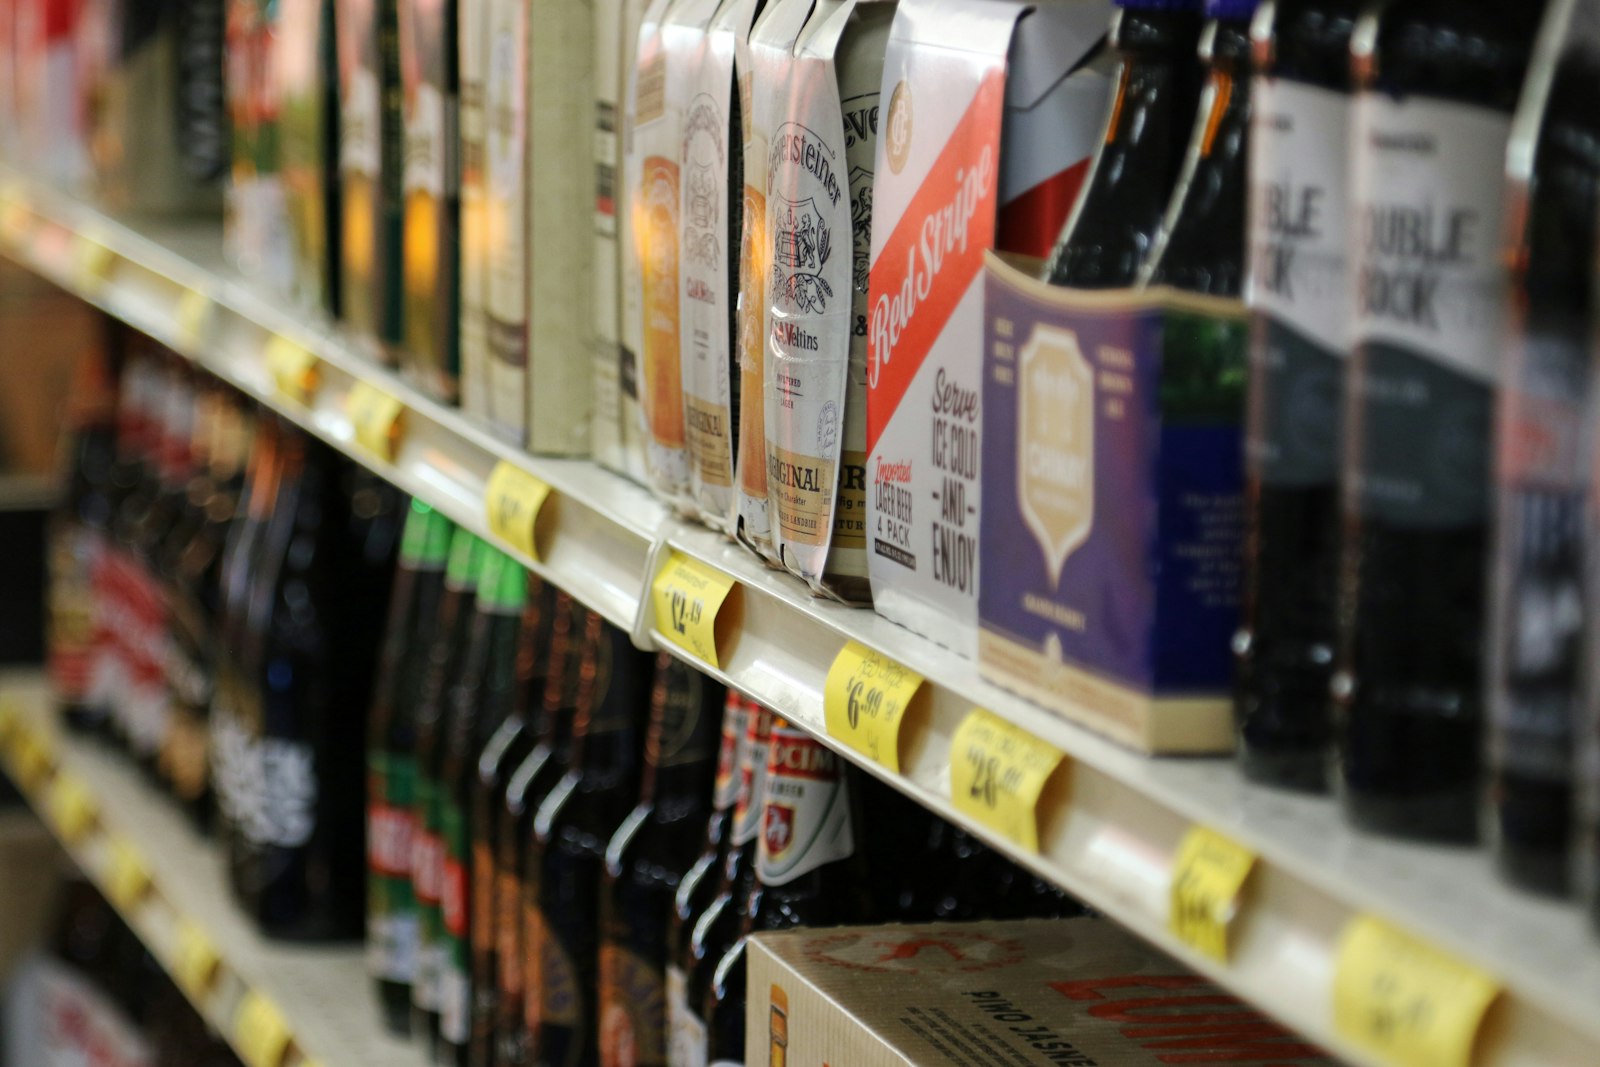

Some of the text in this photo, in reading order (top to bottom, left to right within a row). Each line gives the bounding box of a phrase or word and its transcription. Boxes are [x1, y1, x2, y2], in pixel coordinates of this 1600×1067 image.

[870, 144, 993, 390] Red Stripe
[932, 367, 978, 423] Serve
[874, 456, 912, 485] Imported
[932, 417, 977, 481] ICE COLD
[875, 481, 895, 518] LAGER
[896, 486, 912, 526] BEER
[878, 514, 910, 549] 4 PACK
[932, 521, 976, 597] ENJOY
